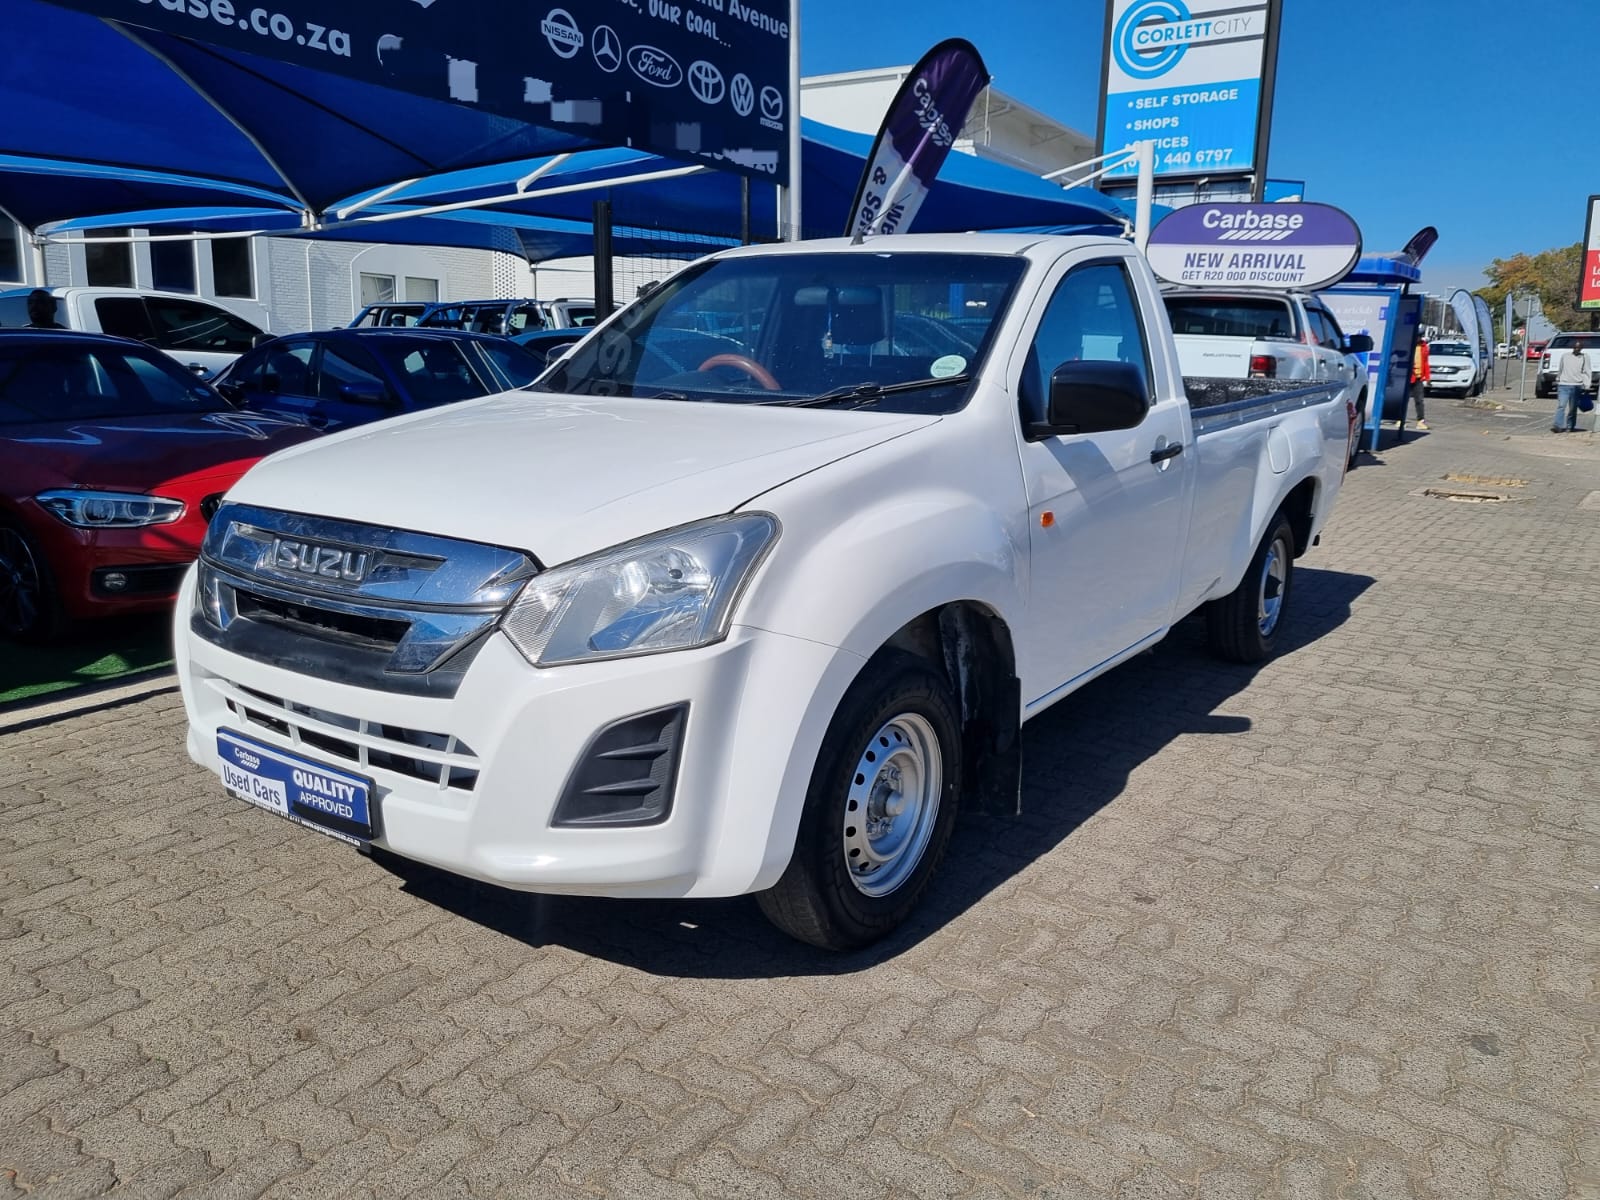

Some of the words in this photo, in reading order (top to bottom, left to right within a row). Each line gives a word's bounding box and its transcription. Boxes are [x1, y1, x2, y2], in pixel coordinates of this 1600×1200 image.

[729, 0, 789, 39] Avenue
[543, 22, 582, 44] NISSAN
[638, 50, 672, 81] Ford
[1136, 96, 1168, 110] SELF
[1172, 89, 1238, 106] STORAGE
[1134, 116, 1179, 130] SHOPS
[1164, 151, 1191, 165] 440
[1195, 148, 1233, 163] 6797
[1202, 209, 1304, 229] Carbase
[1184, 252, 1224, 268] NEW
[1228, 253, 1306, 270] ARRIVAL
[1181, 271, 1200, 281] GET
[1204, 271, 1223, 281] R20
[1226, 271, 1246, 281] 000
[1249, 271, 1304, 283] DISCOUNT
[271, 538, 367, 582] ISUZU
[234, 747, 260, 764] Carbase
[223, 765, 249, 793] Used
[253, 778, 281, 806] Cars
[292, 769, 355, 803] QUALITY
[300, 791, 353, 818] APPROVED
